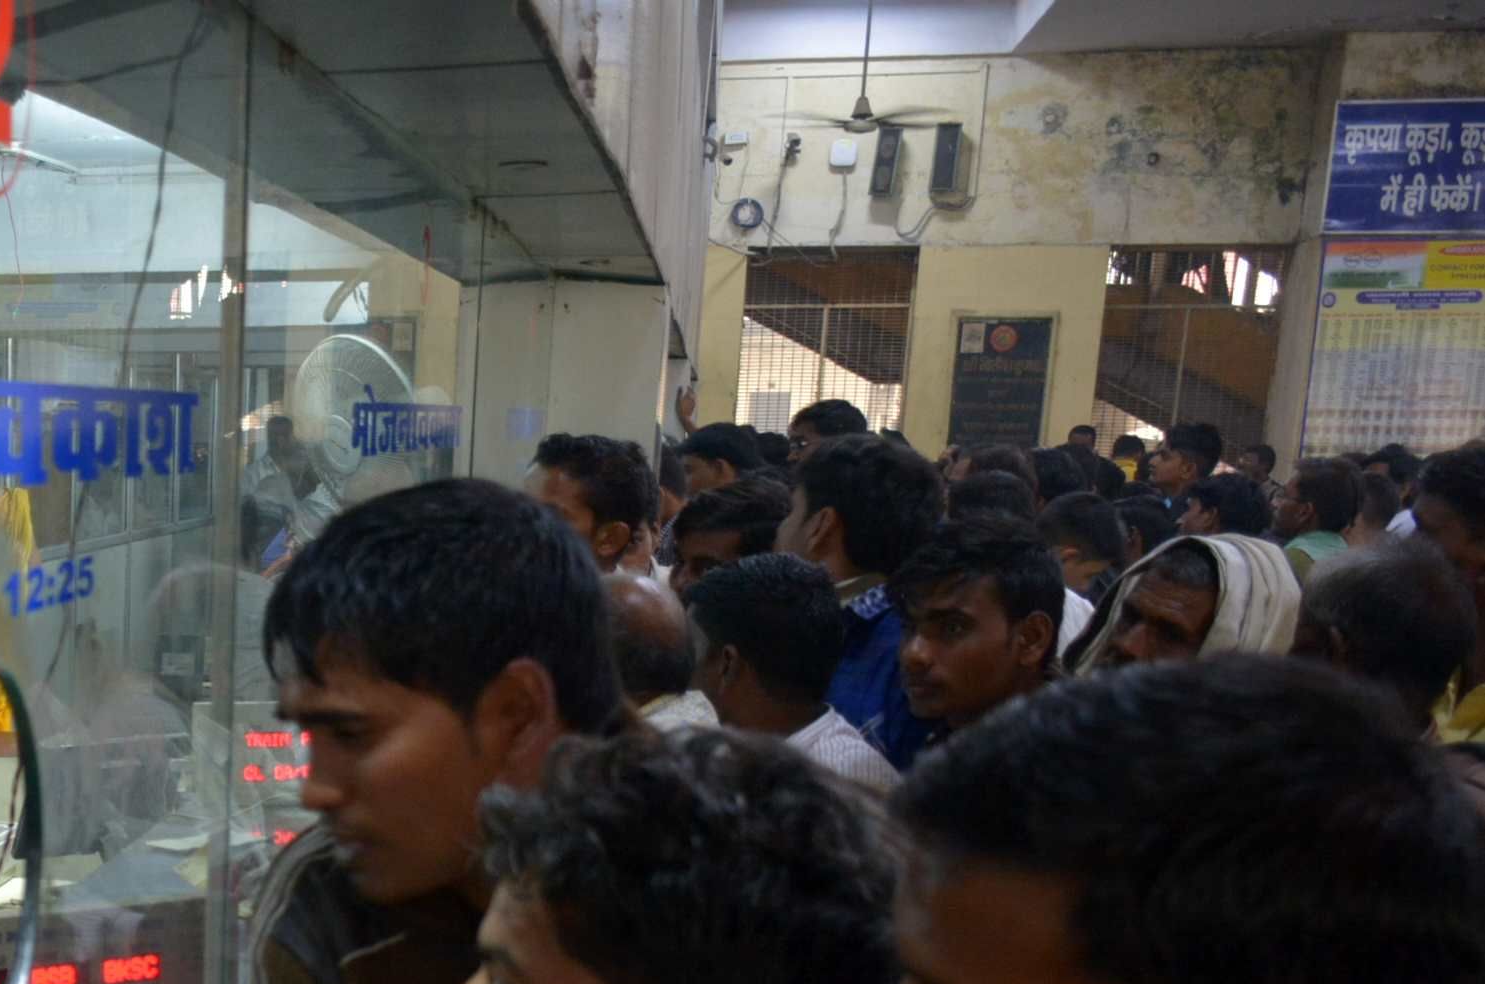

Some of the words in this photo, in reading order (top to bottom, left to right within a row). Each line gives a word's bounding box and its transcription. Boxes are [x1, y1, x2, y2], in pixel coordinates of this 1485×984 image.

[1345, 124, 1403, 165] कृपया
[1380, 174, 1403, 213] में
[1403, 173, 1427, 216] ही
[4, 554, 95, 617] 12:25
[244, 731, 293, 748] TRAIN
